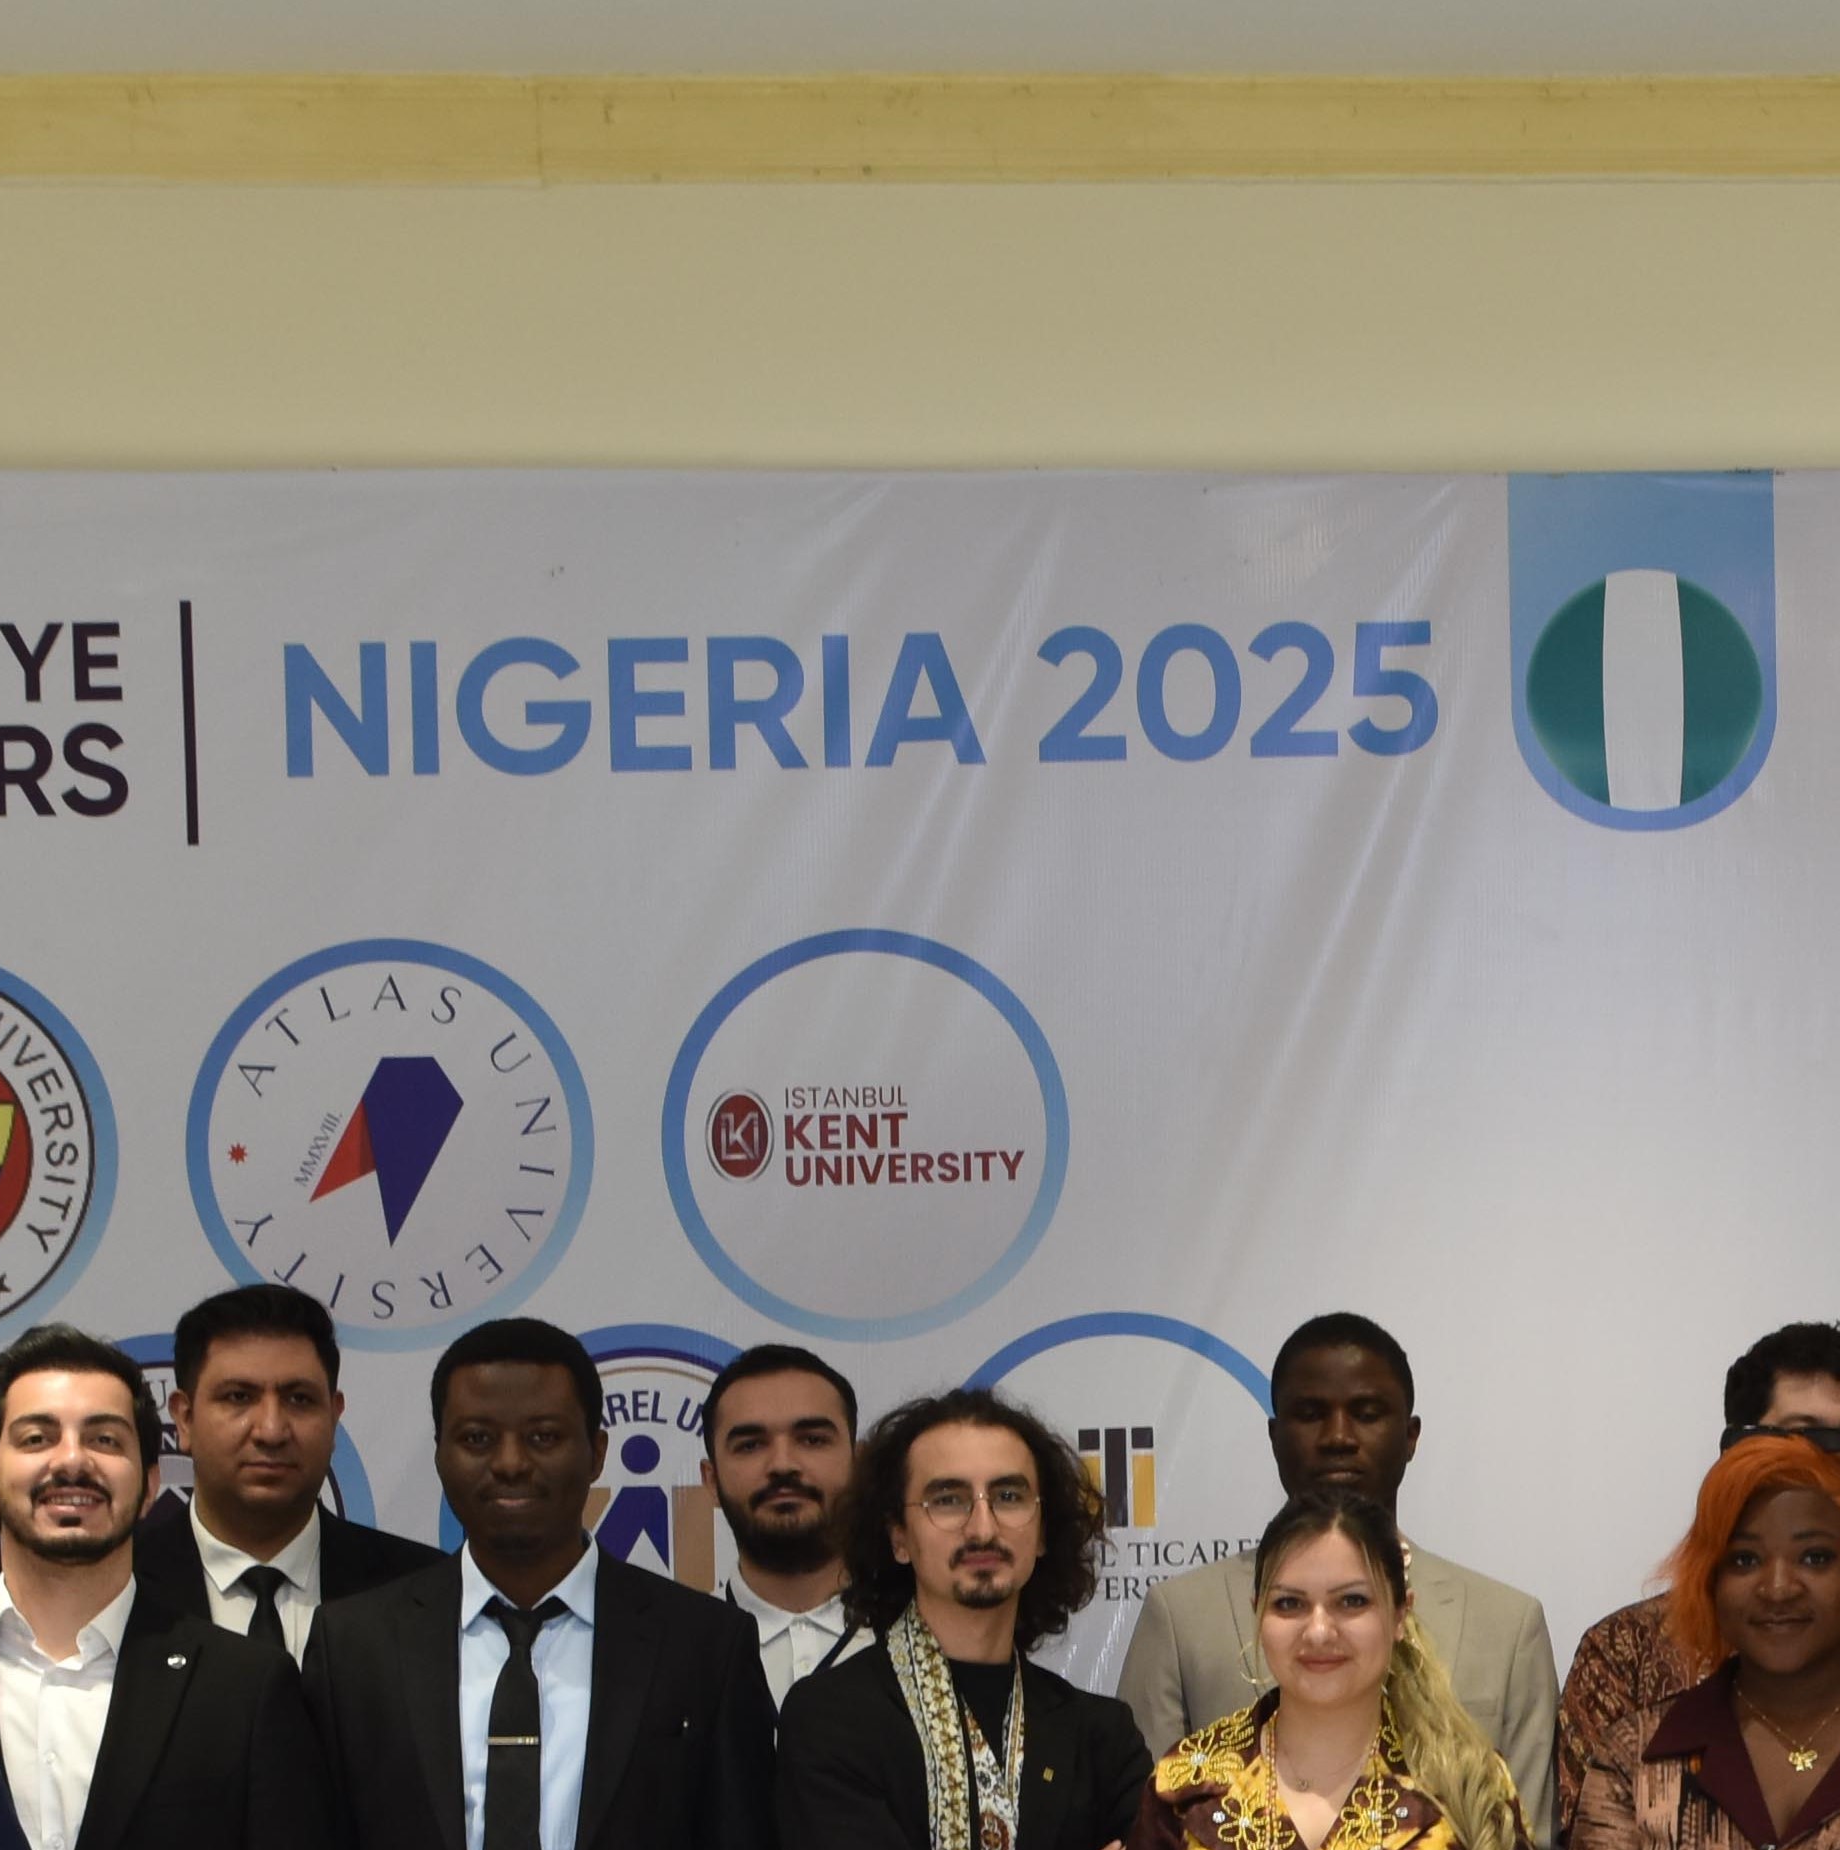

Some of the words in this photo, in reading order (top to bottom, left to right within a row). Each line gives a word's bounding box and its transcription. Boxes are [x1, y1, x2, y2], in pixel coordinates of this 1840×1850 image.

[282, 632, 987, 778] NIGERIA
[1037, 619, 1440, 765] 2025
[237, 973, 463, 1098] ATLAS
[784, 1086, 908, 1109] ISTANBUL
[784, 1112, 908, 1150] KENT
[234, 1031, 557, 1320] UNIVERSITY
[785, 1150, 1025, 1187] UNIVERSITY
